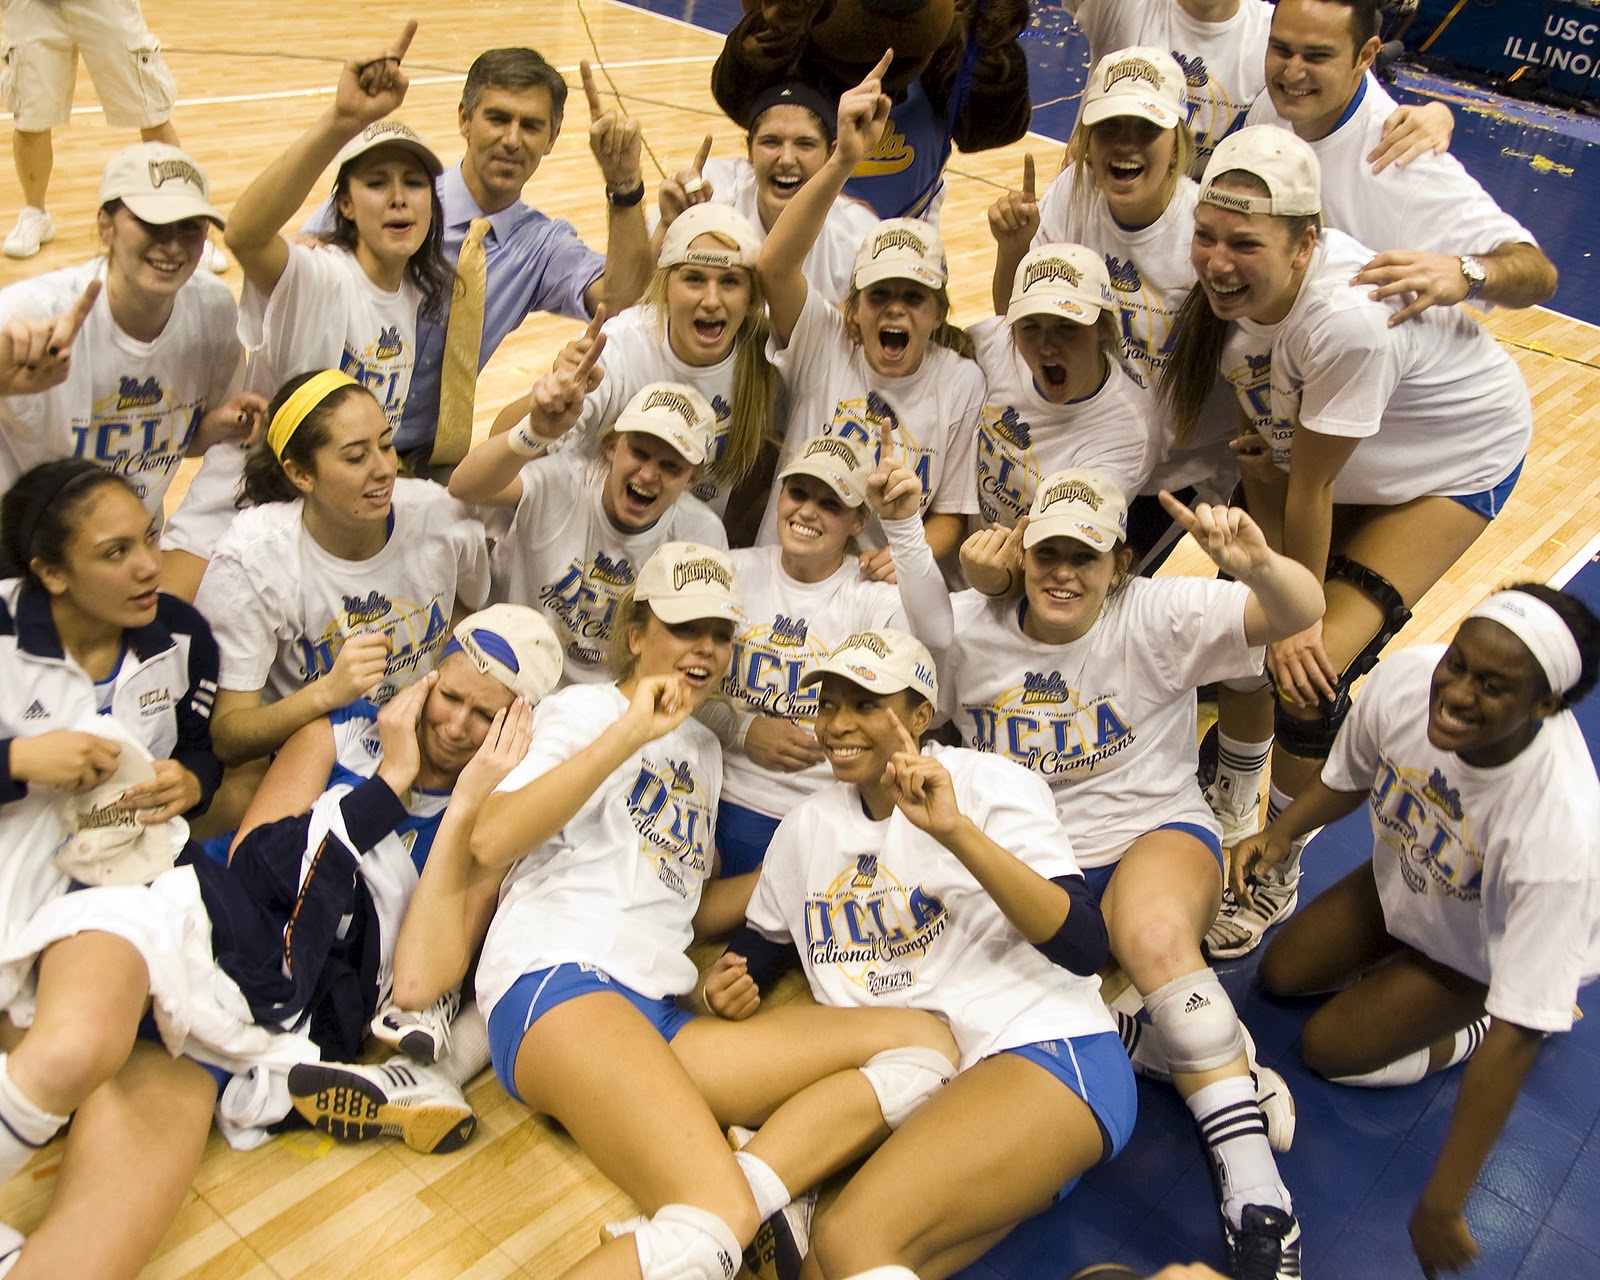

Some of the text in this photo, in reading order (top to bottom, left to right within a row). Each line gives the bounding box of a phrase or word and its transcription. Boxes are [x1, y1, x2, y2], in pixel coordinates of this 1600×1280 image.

[1544, 14, 1600, 46] USC
[1503, 36, 1600, 80] ILLINOI
[1206, 190, 1250, 211] Champions
[687, 252, 730, 265] Champions
[772, 614, 807, 637] Ucla
[914, 660, 935, 690] Ucla
[1024, 671, 1068, 692] Ucla
[139, 687, 170, 709] UCLA
[1021, 688, 1069, 705] BRUINS
[1001, 707, 1036, 717] DIVISION
[966, 701, 1133, 760] UCLA
[1039, 725, 1137, 776] Champions
[851, 874, 875, 888] BRU
[804, 885, 947, 947] UCLA
[807, 937, 881, 968] National
[1184, 996, 1211, 1014] adidas
